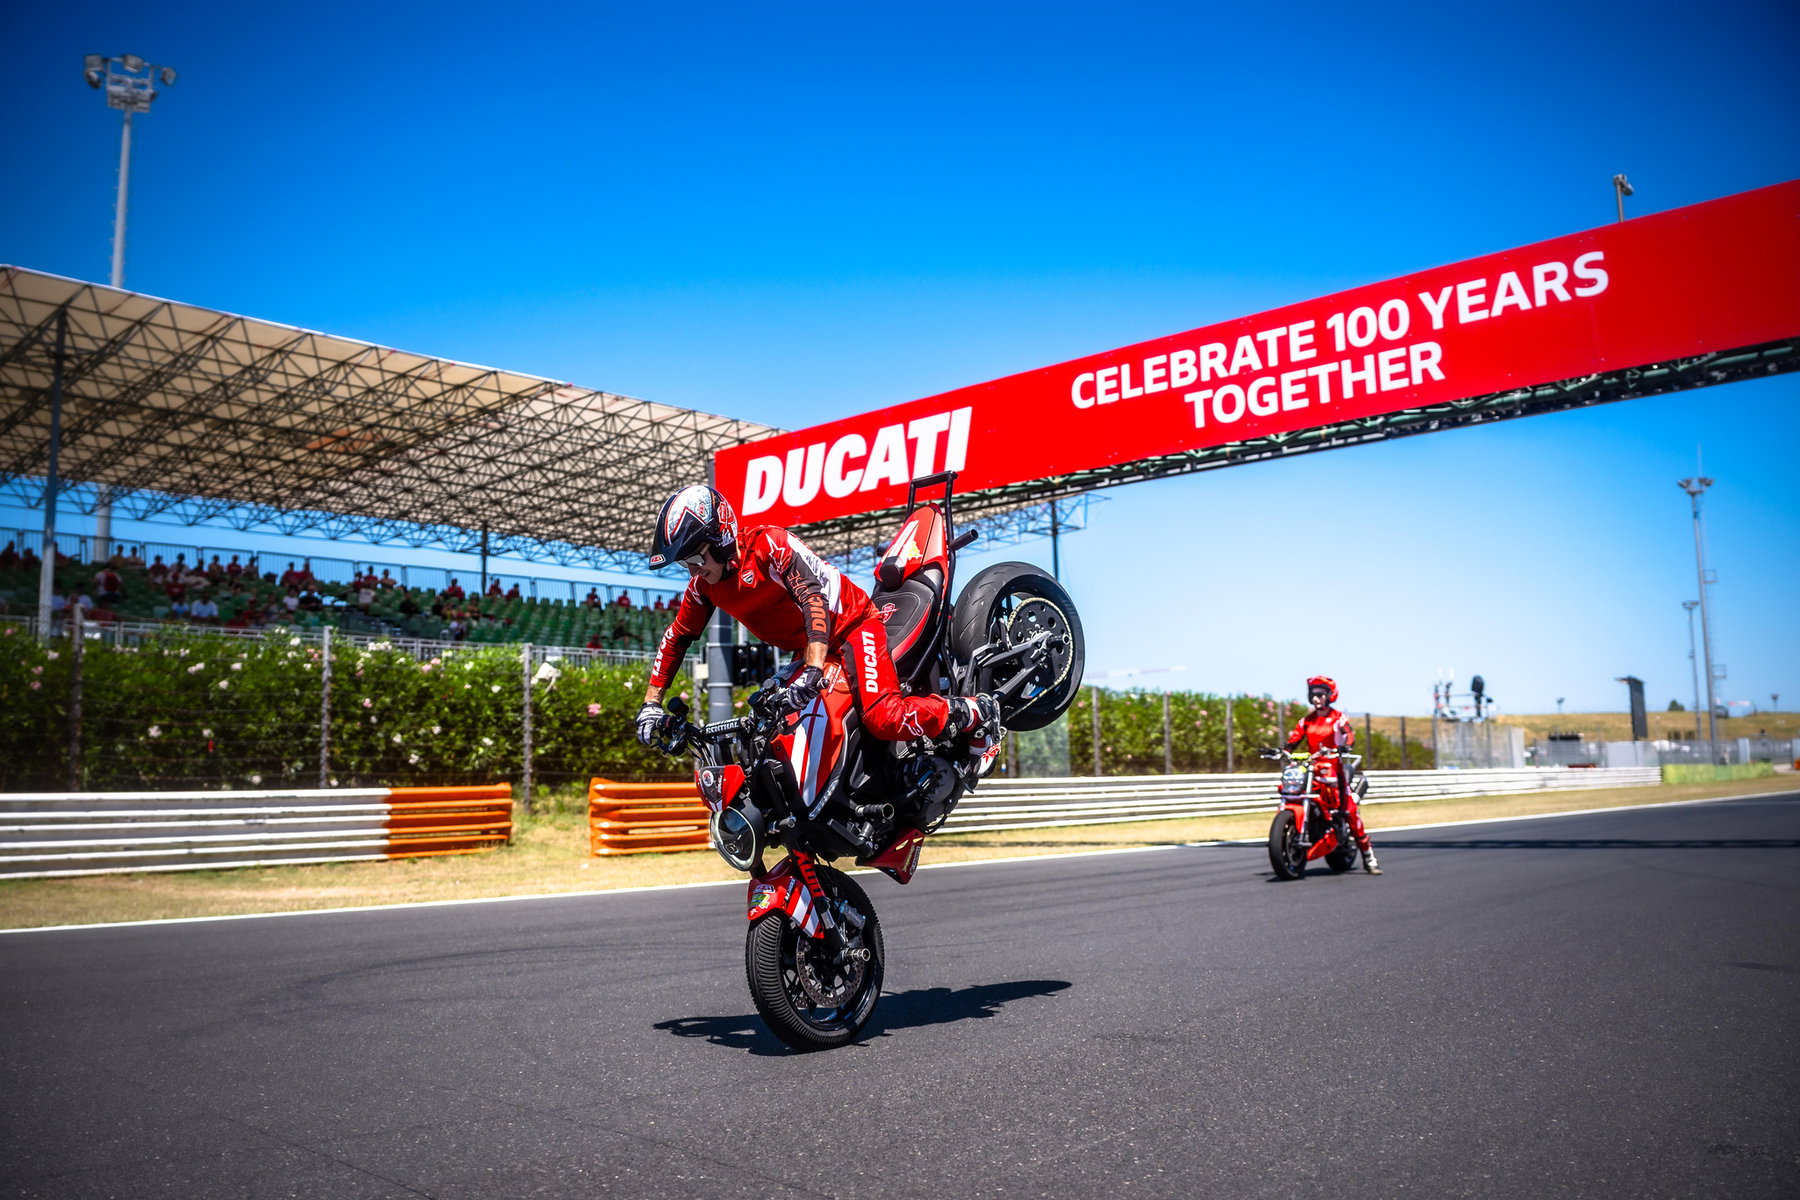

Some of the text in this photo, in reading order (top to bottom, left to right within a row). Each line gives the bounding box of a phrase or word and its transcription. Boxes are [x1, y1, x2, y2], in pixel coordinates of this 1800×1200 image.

[1071, 251, 1609, 409] CELEBRATE 100 YEARS
[1184, 341, 1446, 429] TOGETHER
[741, 406, 973, 517] DUCATI
[861, 630, 879, 693] DUCATI
